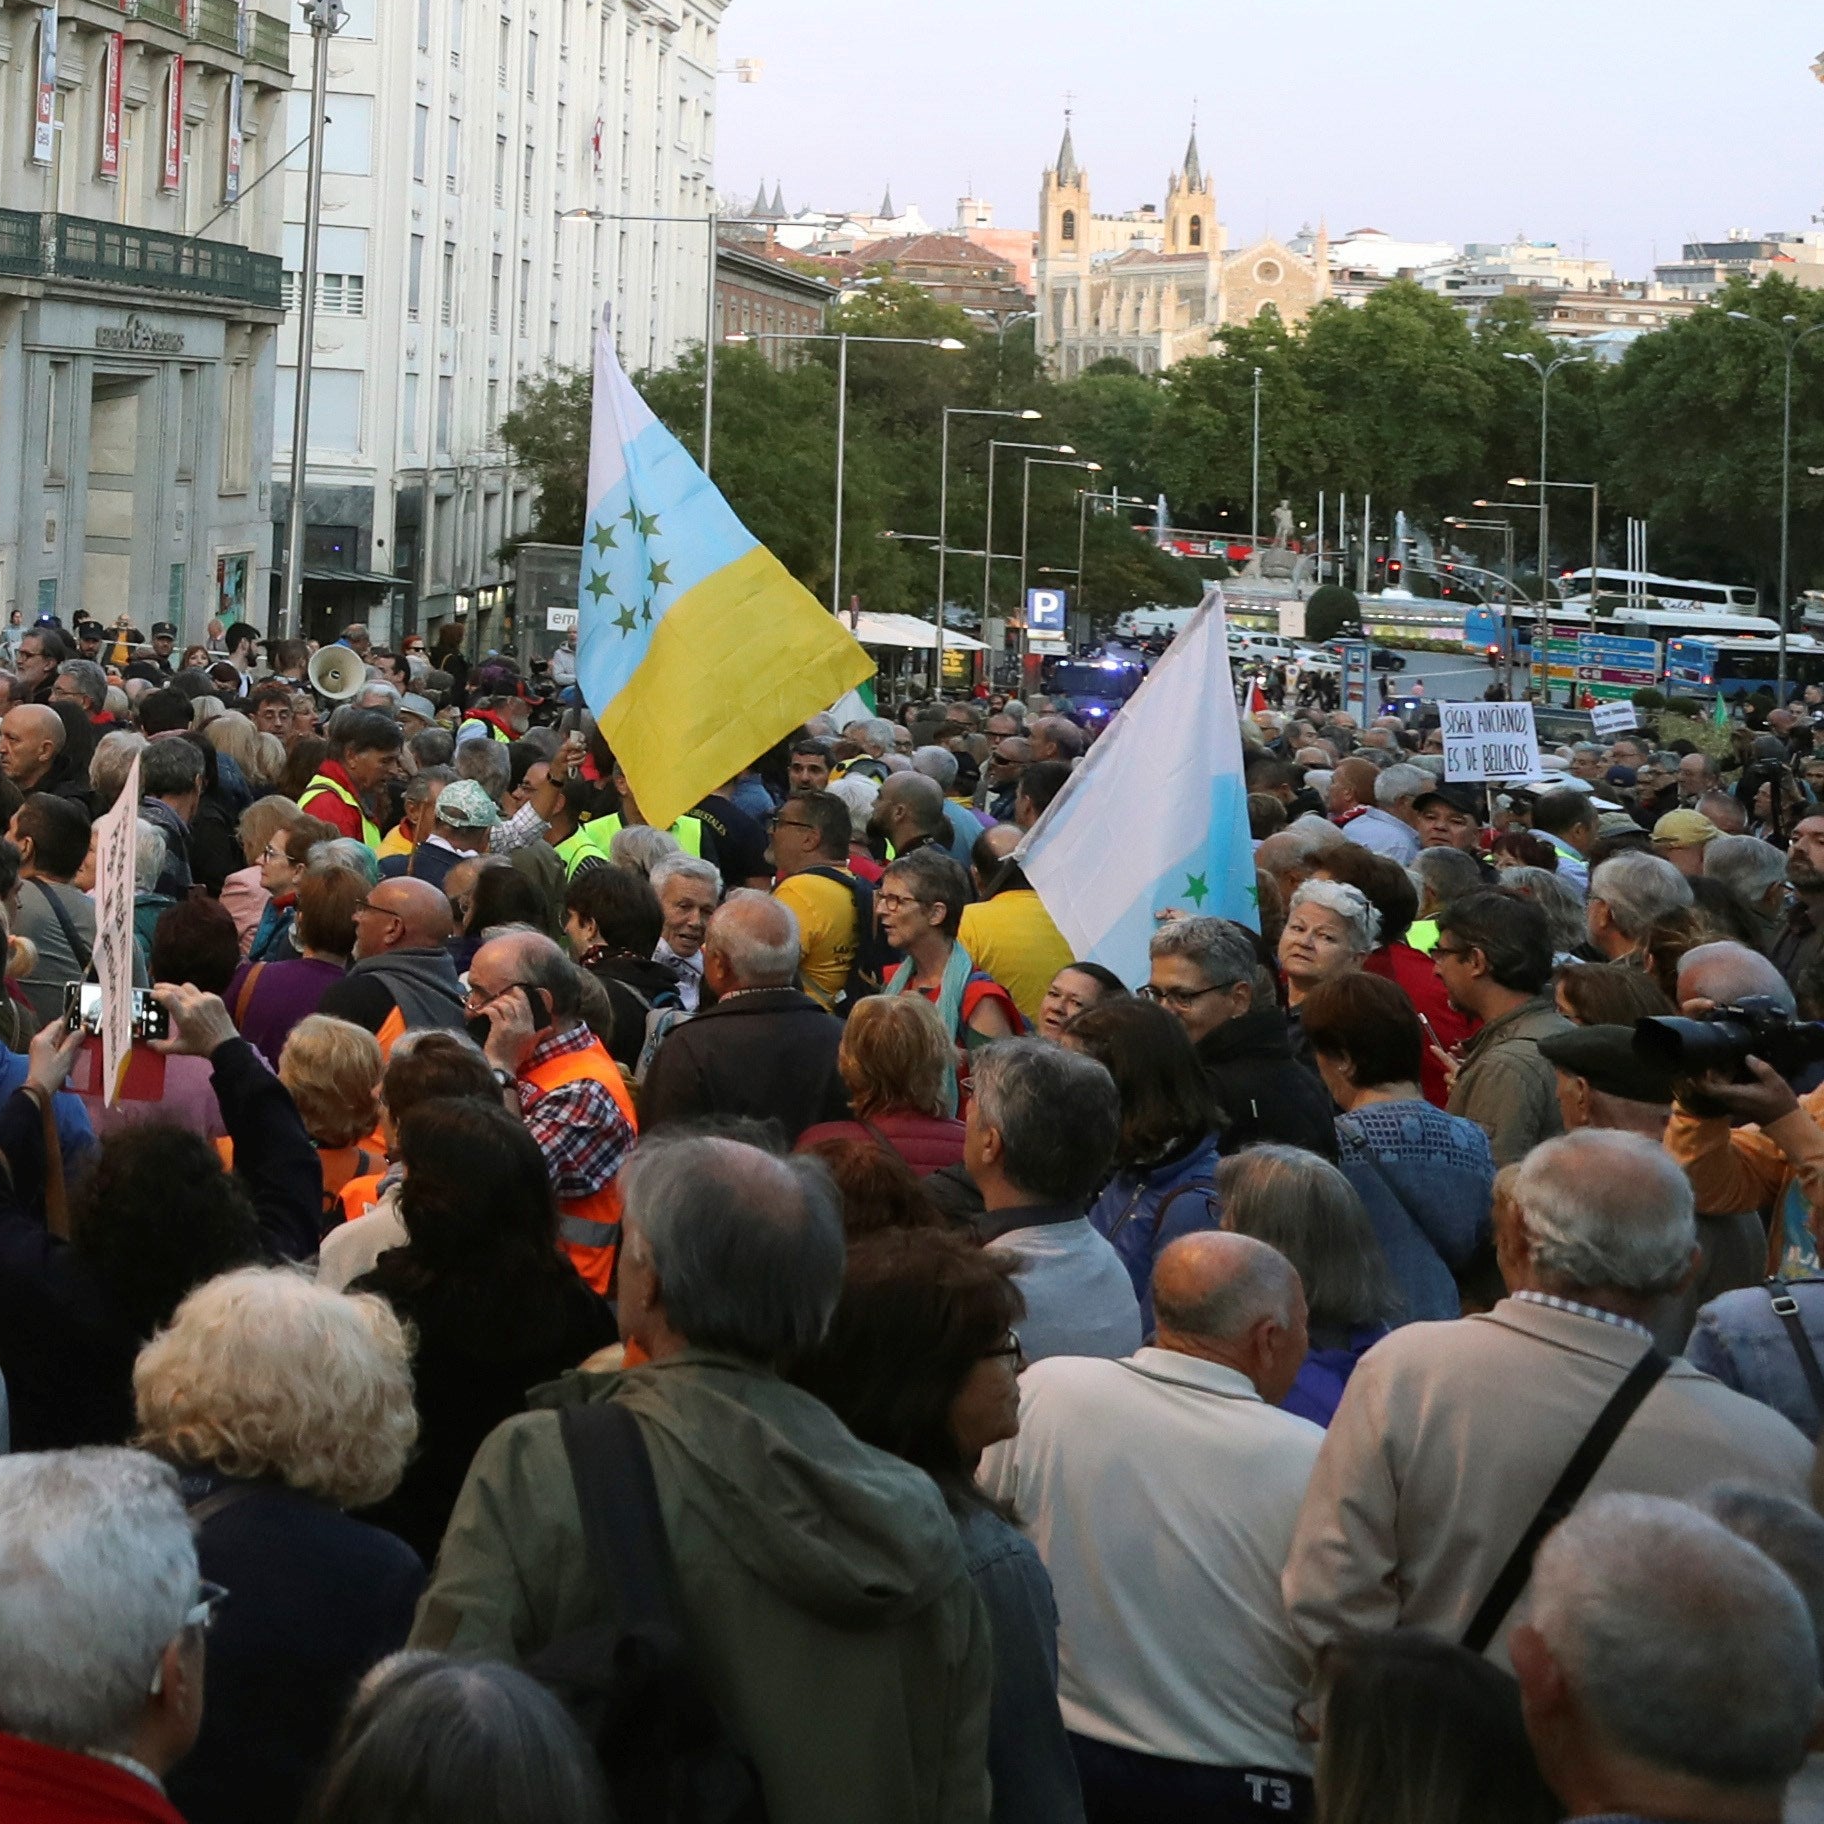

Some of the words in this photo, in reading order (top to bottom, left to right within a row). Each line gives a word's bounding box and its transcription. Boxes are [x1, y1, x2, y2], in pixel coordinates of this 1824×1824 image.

[1034, 592, 1059, 623] P
[1447, 747, 1460, 772] ES
[1465, 746, 1477, 771] DE
[1482, 743, 1533, 772] BELLACOS.
[1245, 1773, 1292, 1810] T3
